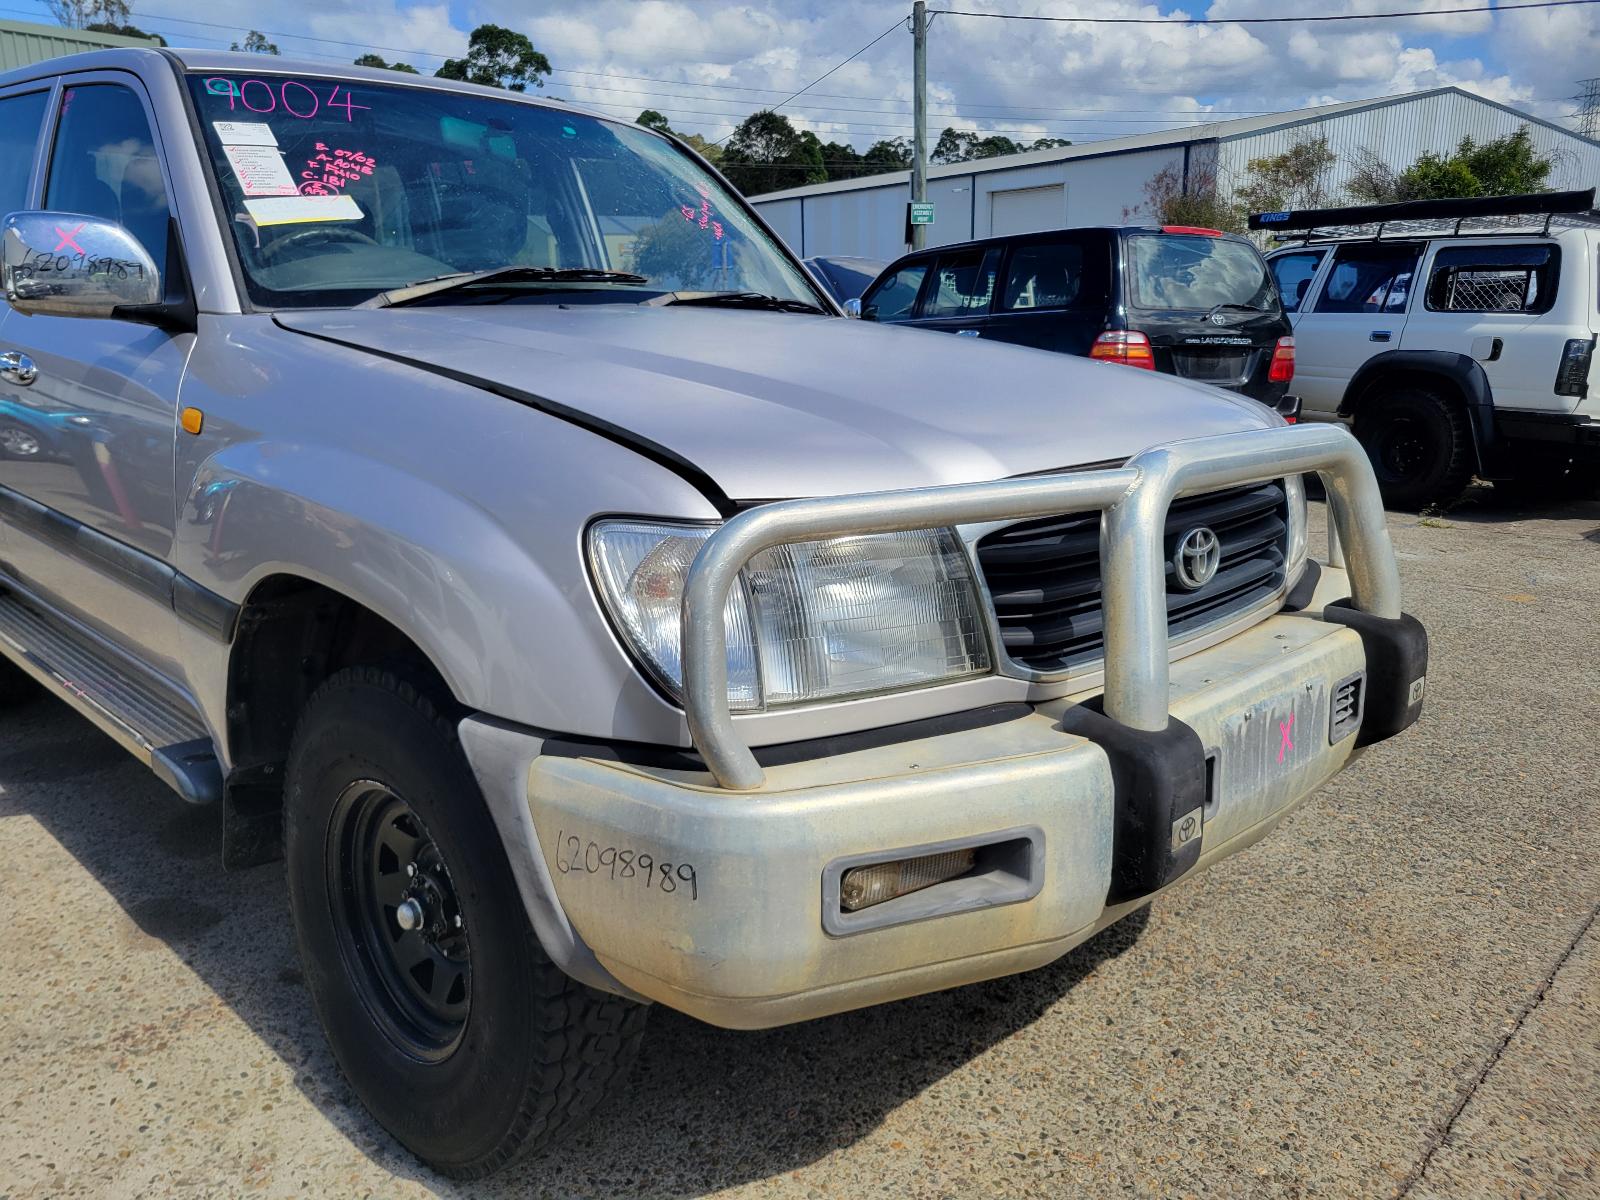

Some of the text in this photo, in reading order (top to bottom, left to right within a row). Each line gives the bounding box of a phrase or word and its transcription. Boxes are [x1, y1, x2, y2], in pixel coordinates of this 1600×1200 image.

[206, 78, 372, 122] 9004
[1260, 212, 1290, 222] KINGS
[22, 247, 143, 280] 62098989
[556, 830, 697, 900] 62098989
